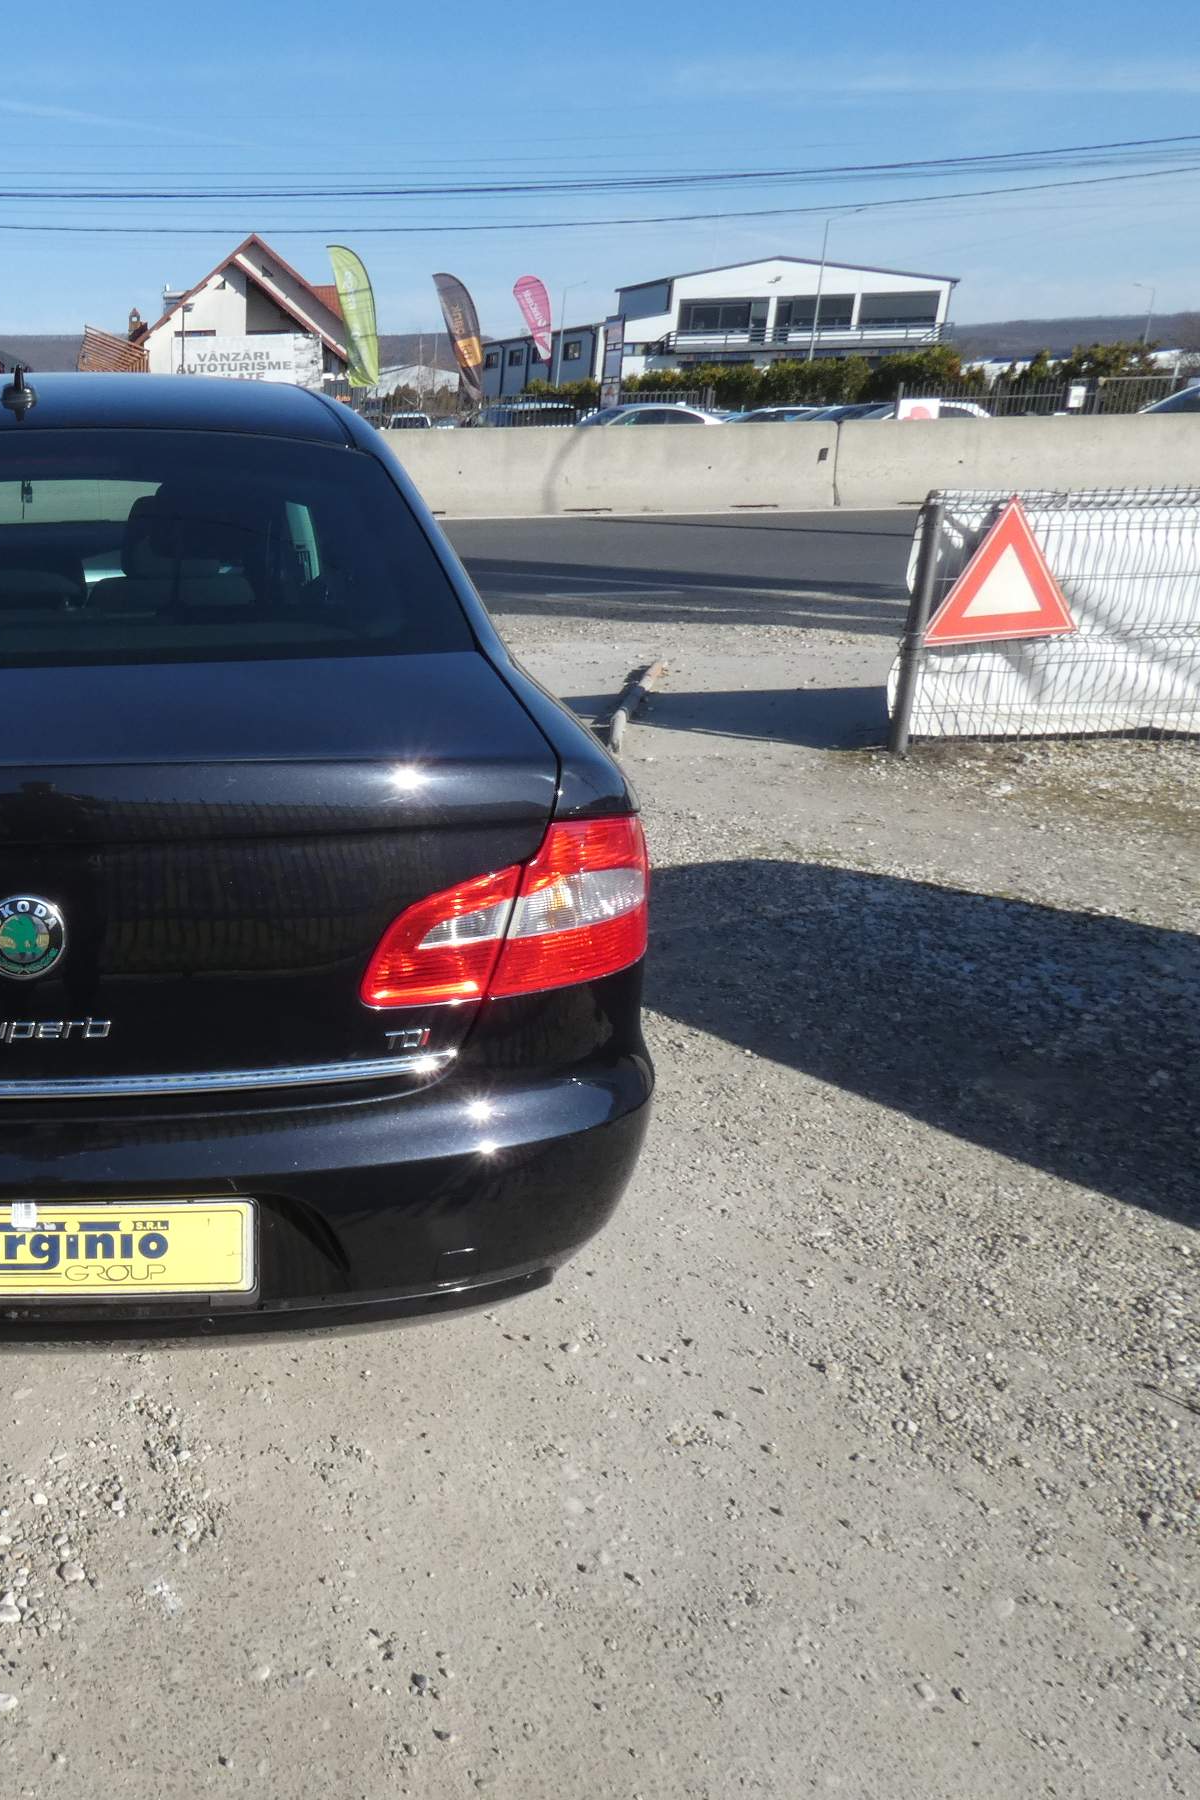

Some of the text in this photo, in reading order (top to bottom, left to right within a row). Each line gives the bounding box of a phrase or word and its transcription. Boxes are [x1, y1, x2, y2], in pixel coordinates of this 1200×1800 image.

[176, 361, 292, 374] AUTOTURISME
[385, 1028, 431, 1050] TDI
[65, 1264, 167, 1282] GROUP
